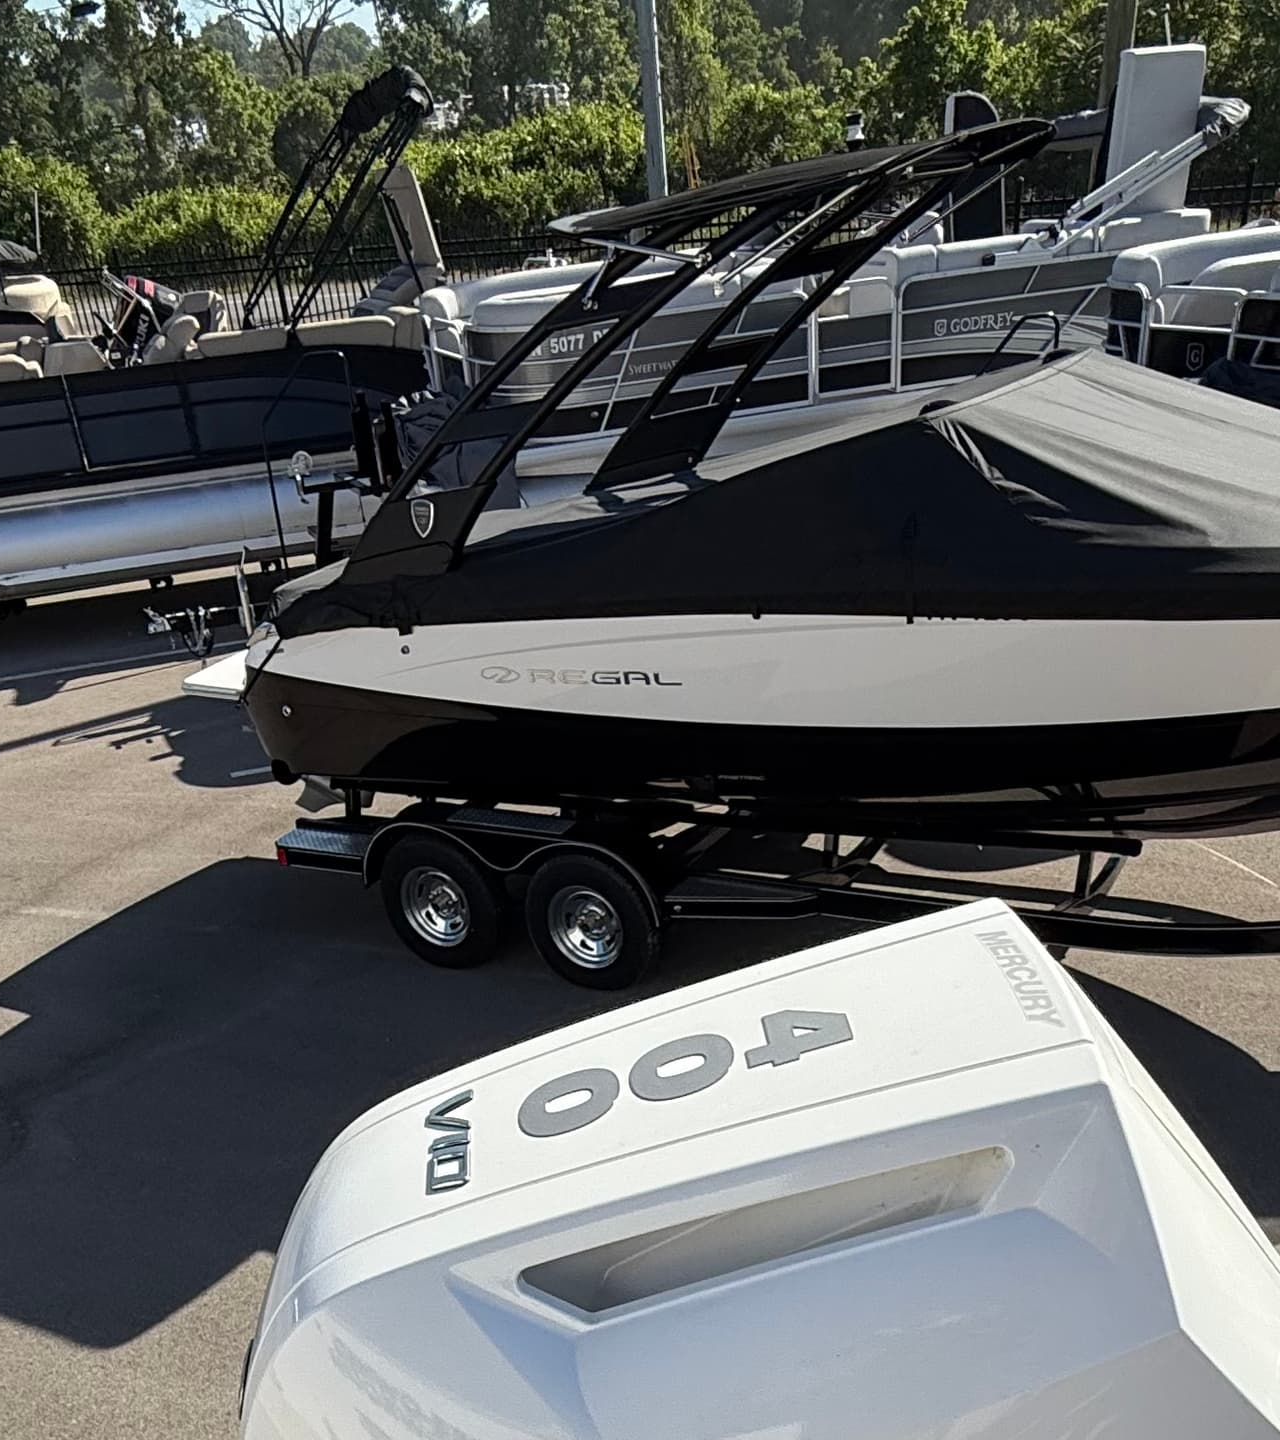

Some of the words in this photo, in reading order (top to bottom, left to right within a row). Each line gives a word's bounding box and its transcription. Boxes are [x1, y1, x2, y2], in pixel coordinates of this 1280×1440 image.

[550, 333, 585, 354] 5077
[950, 311, 1014, 333] GODFREY
[528, 668, 683, 686] REGAL
[975, 930, 1065, 1028] MERCURY
[517, 1009, 854, 1138] 400
[425, 1089, 474, 1195] V10
